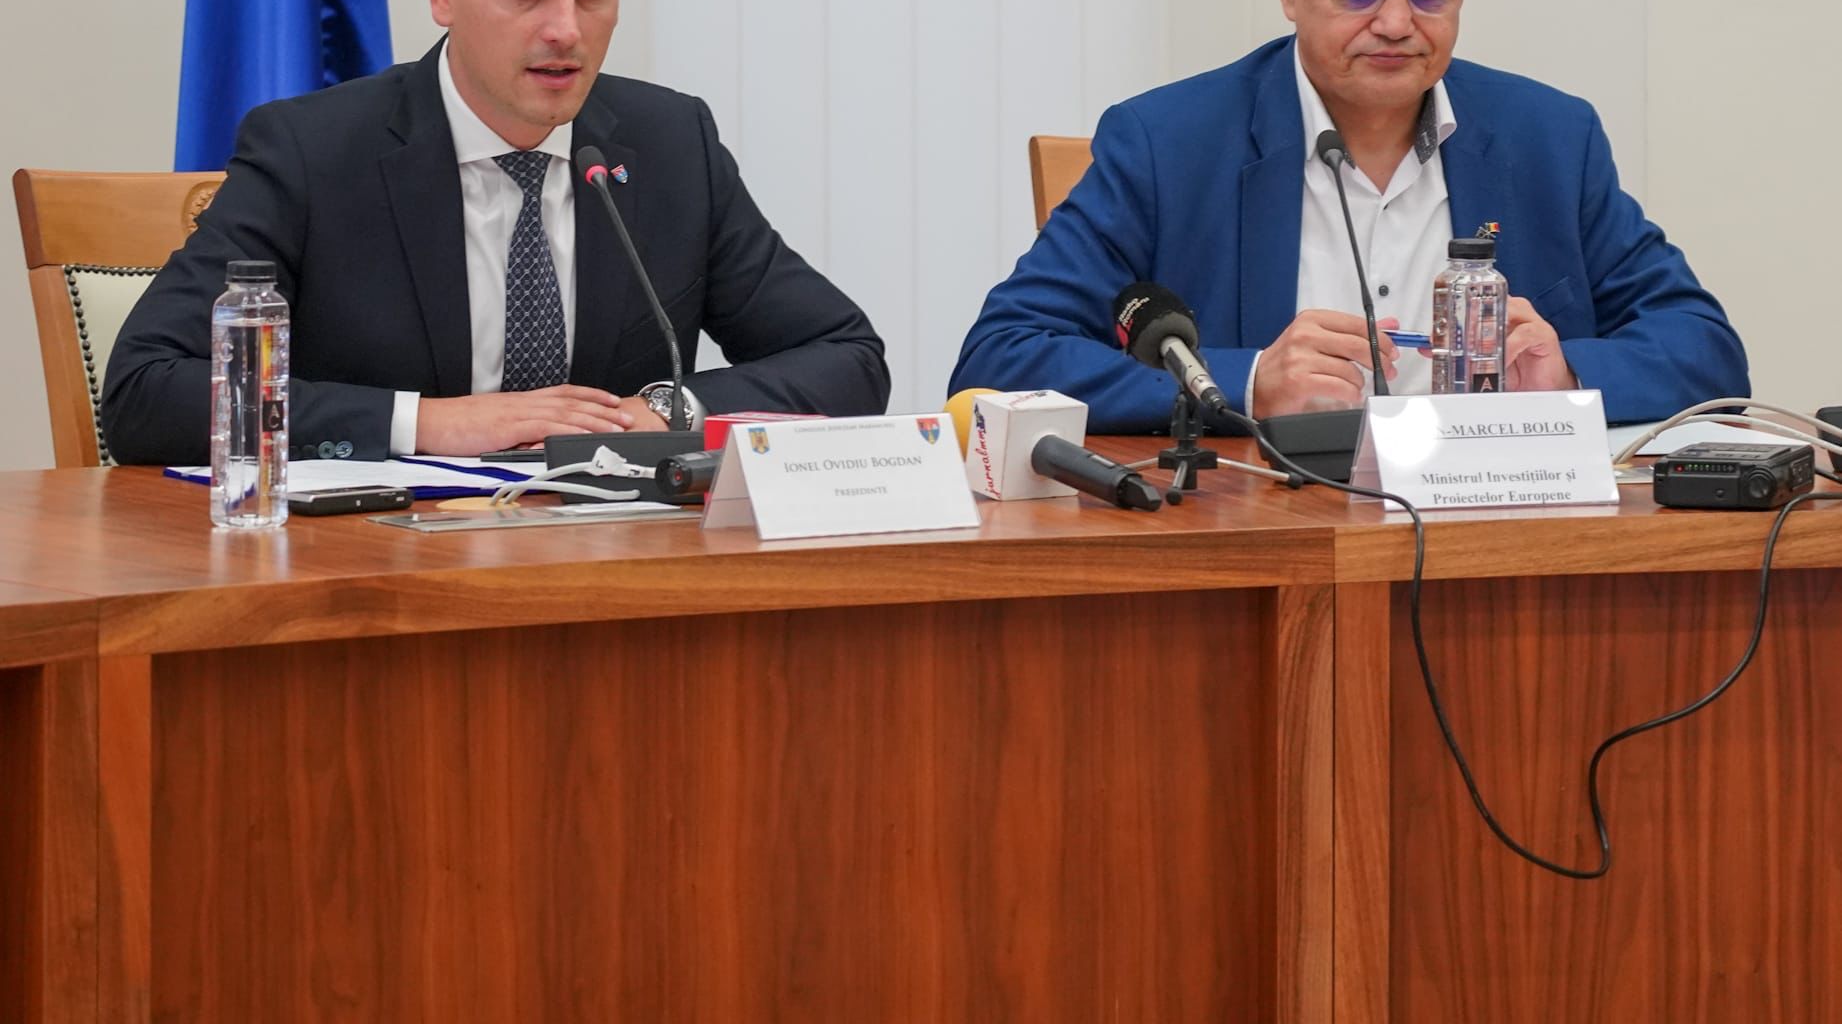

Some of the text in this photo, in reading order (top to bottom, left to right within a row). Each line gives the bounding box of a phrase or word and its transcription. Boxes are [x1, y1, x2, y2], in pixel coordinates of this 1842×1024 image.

[1440, 423, 1520, 437] -MARCEL
[783, 455, 922, 473] IONEL OVIDIU BOGDAN
[1421, 467, 1577, 486] Ministrul Investițiilor și
[1432, 489, 1572, 506] Proiectelor Europene
